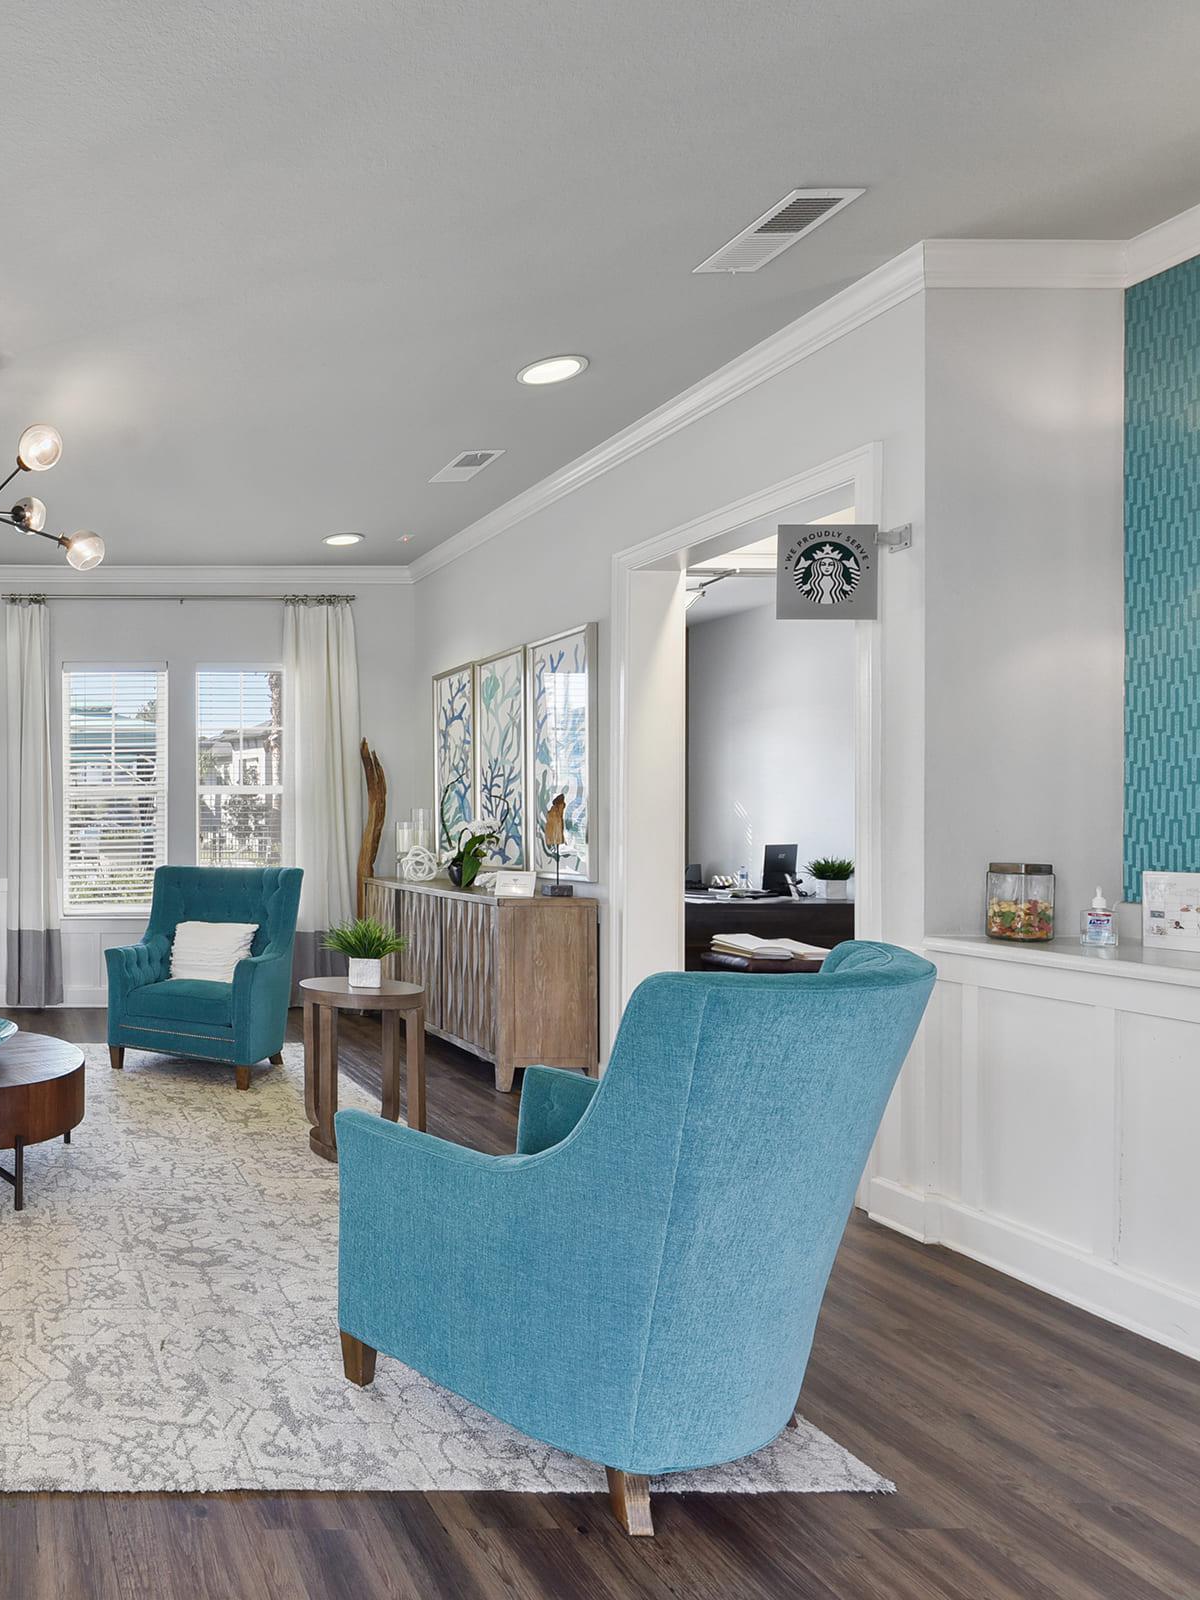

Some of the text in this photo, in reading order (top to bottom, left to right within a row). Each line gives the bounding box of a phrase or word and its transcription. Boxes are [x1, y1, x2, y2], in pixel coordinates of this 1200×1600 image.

[785, 530, 869, 562] WE PROUDLY SERVE
